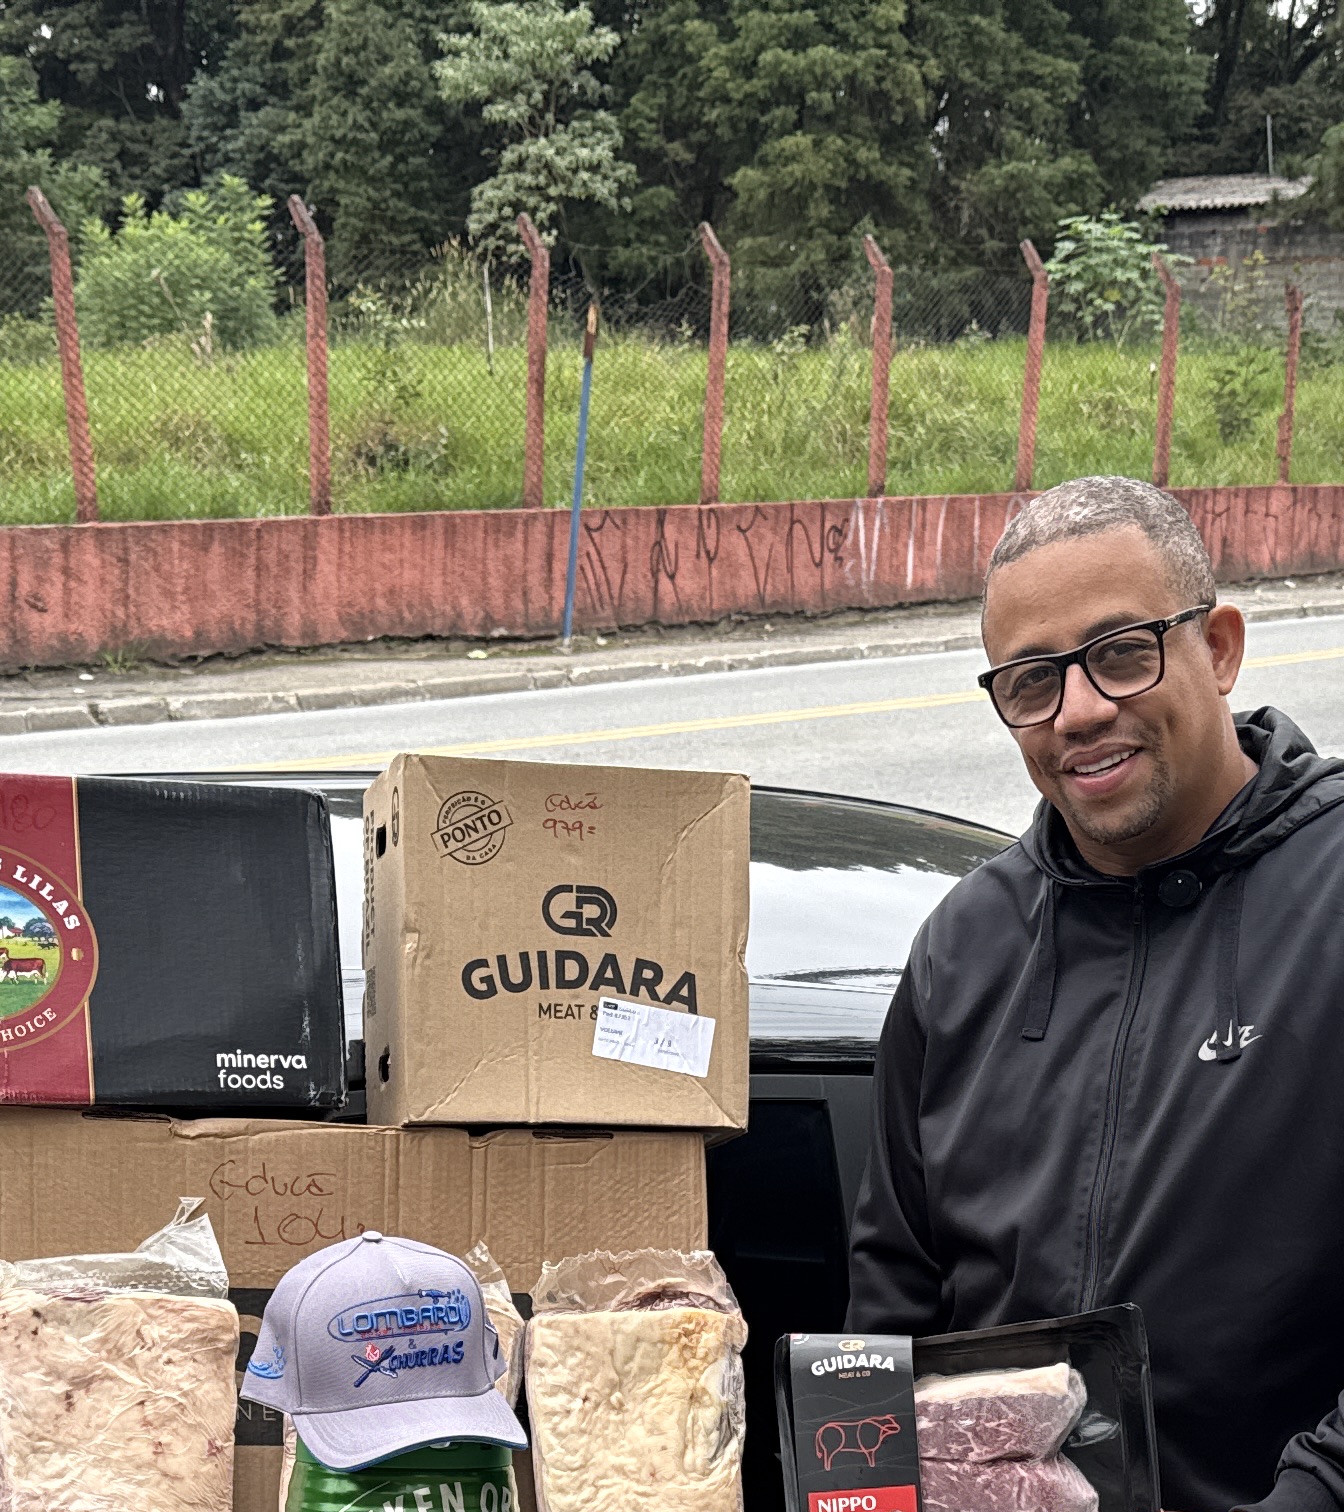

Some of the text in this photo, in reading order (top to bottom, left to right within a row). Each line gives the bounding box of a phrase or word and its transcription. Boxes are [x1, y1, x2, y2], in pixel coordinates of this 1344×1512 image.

[440, 809, 502, 849] PONTO
[12, 864, 81, 931] LILAS
[461, 950, 698, 1016] GUIDARA
[538, 1003, 584, 1020] MEAT
[216, 1049, 307, 1069] minerva
[218, 1069, 284, 1089] foods
[388, 1340, 464, 1370] CHURRAS
[811, 1353, 895, 1376] GUIDARA
